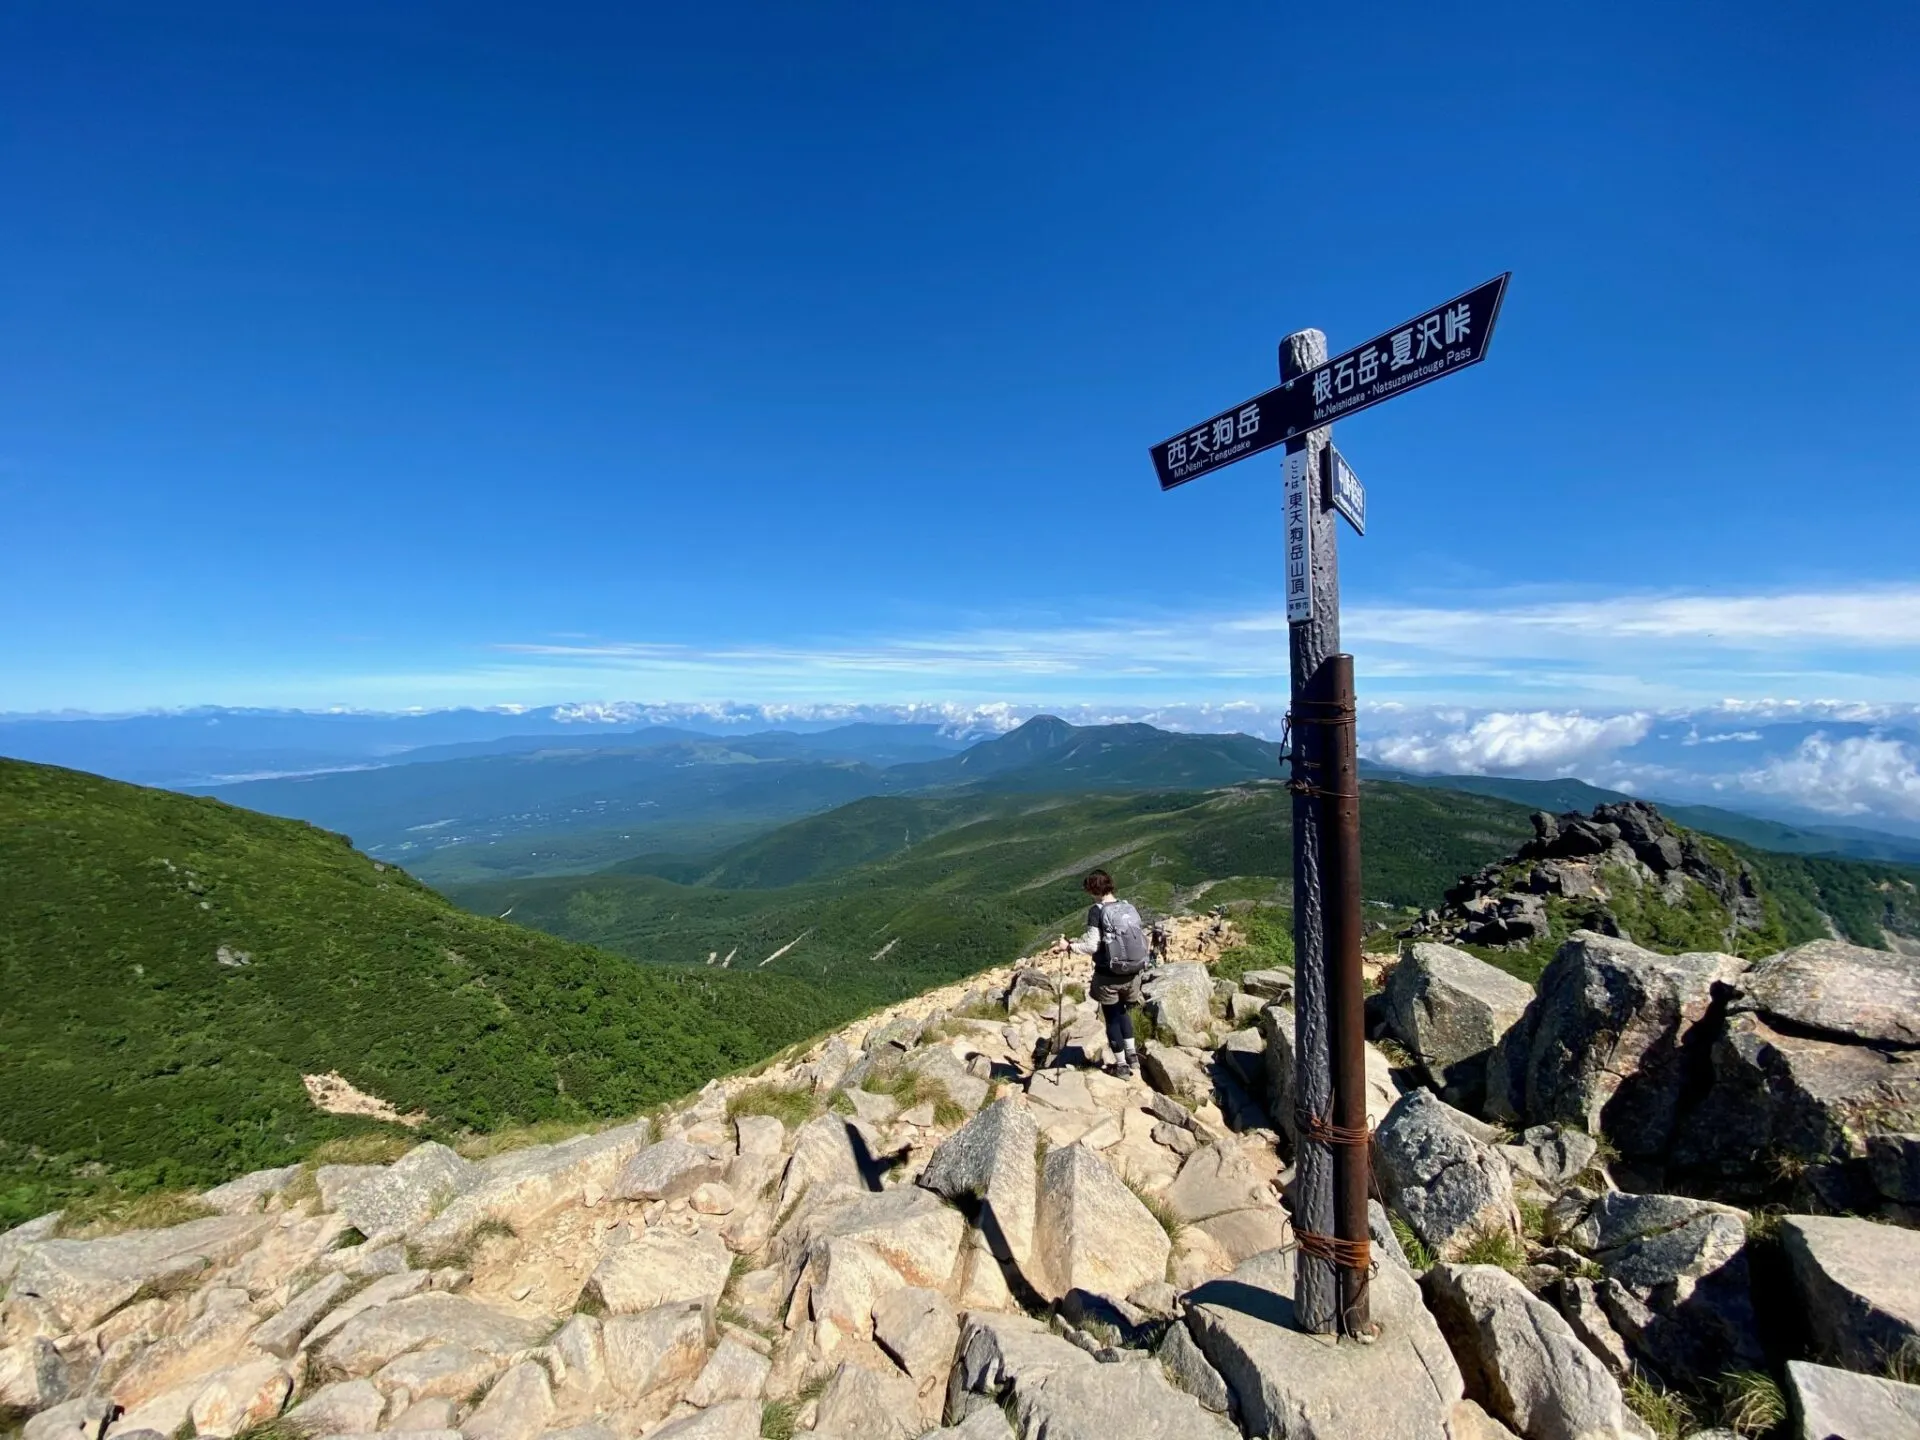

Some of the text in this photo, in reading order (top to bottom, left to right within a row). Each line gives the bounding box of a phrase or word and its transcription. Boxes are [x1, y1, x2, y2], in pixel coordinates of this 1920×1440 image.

[1372, 359, 1444, 396] Natsuzawatouge
[1446, 347, 1471, 365] Pass
[1167, 403, 1260, 470] 西天狗岳
